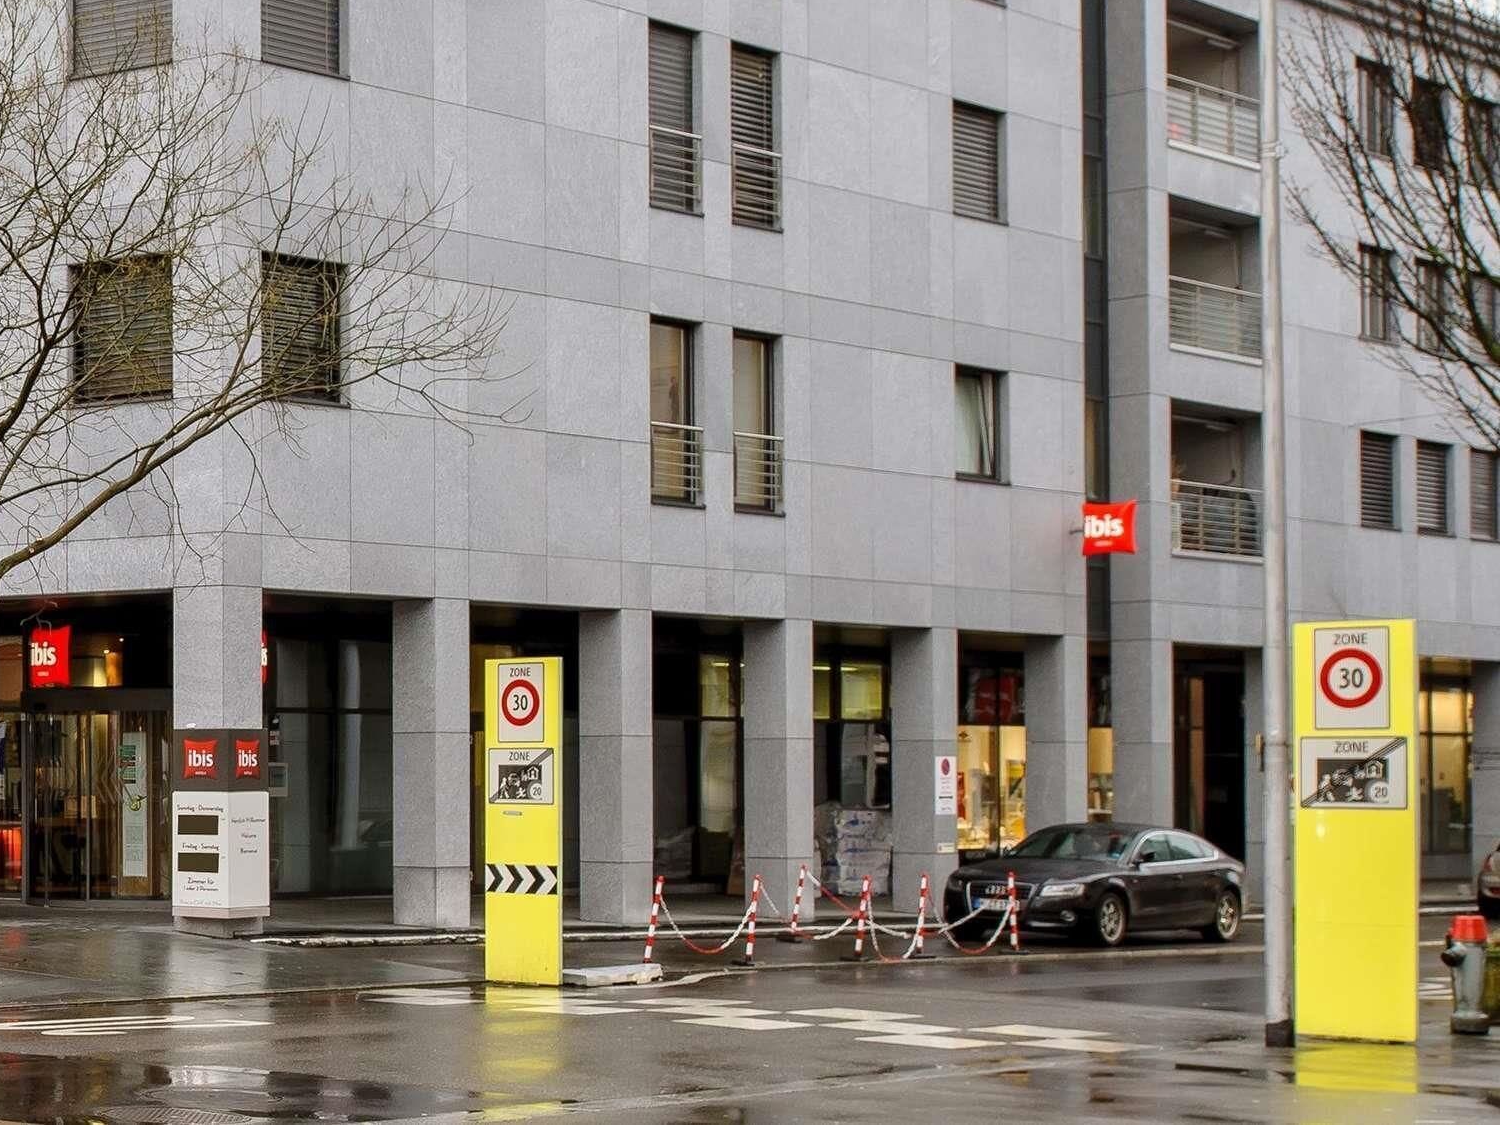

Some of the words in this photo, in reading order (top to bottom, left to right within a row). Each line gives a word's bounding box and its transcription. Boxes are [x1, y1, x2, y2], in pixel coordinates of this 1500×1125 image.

[1084, 513, 1124, 538] ibis
[1333, 633, 1368, 645] ZONE
[31, 641, 57, 666] ibis
[509, 667, 531, 677] ZONE
[1339, 668, 1364, 689] 30
[512, 695, 528, 711] 30
[1334, 741, 1369, 754] ZONE
[188, 749, 214, 767] ibis
[238, 749, 258, 767] ibis
[509, 751, 531, 761] ZONE
[532, 786, 542, 796] 20
[1374, 786, 1388, 797] 20
